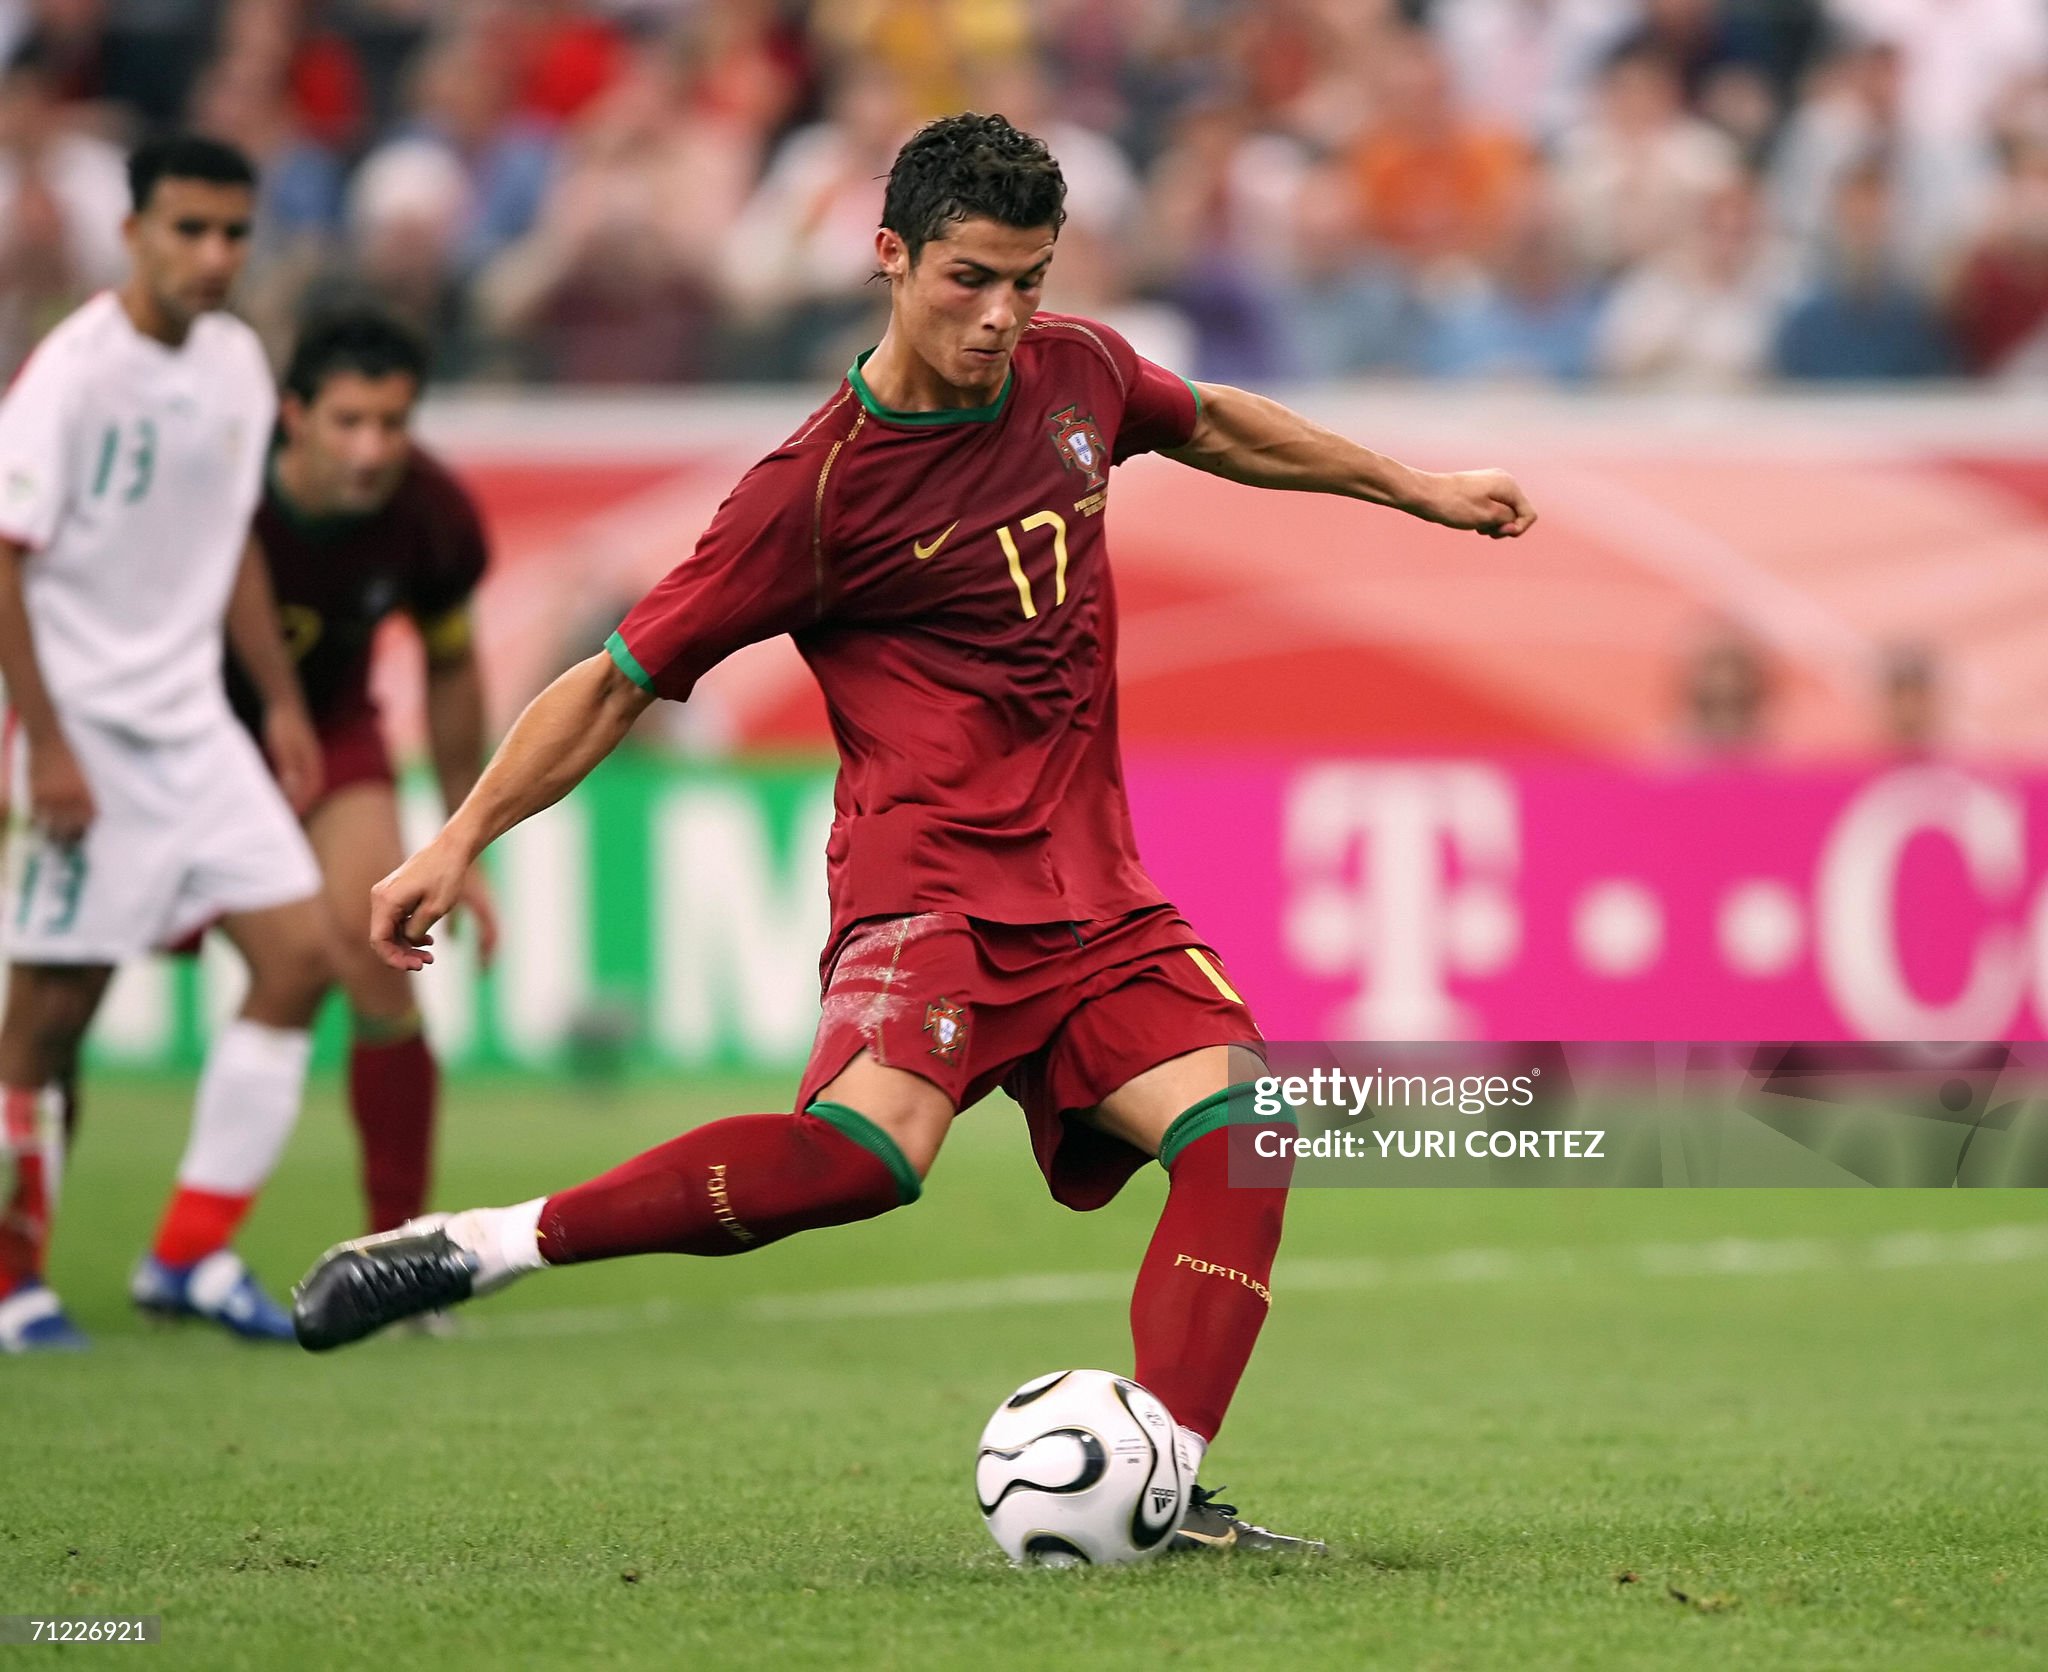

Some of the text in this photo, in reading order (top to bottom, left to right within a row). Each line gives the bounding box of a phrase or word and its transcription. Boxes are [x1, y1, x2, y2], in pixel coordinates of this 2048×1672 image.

[92, 420, 158, 504] 13
[996, 510, 1068, 620] 17
[1173, 1253, 1273, 1308] PORTUGA
